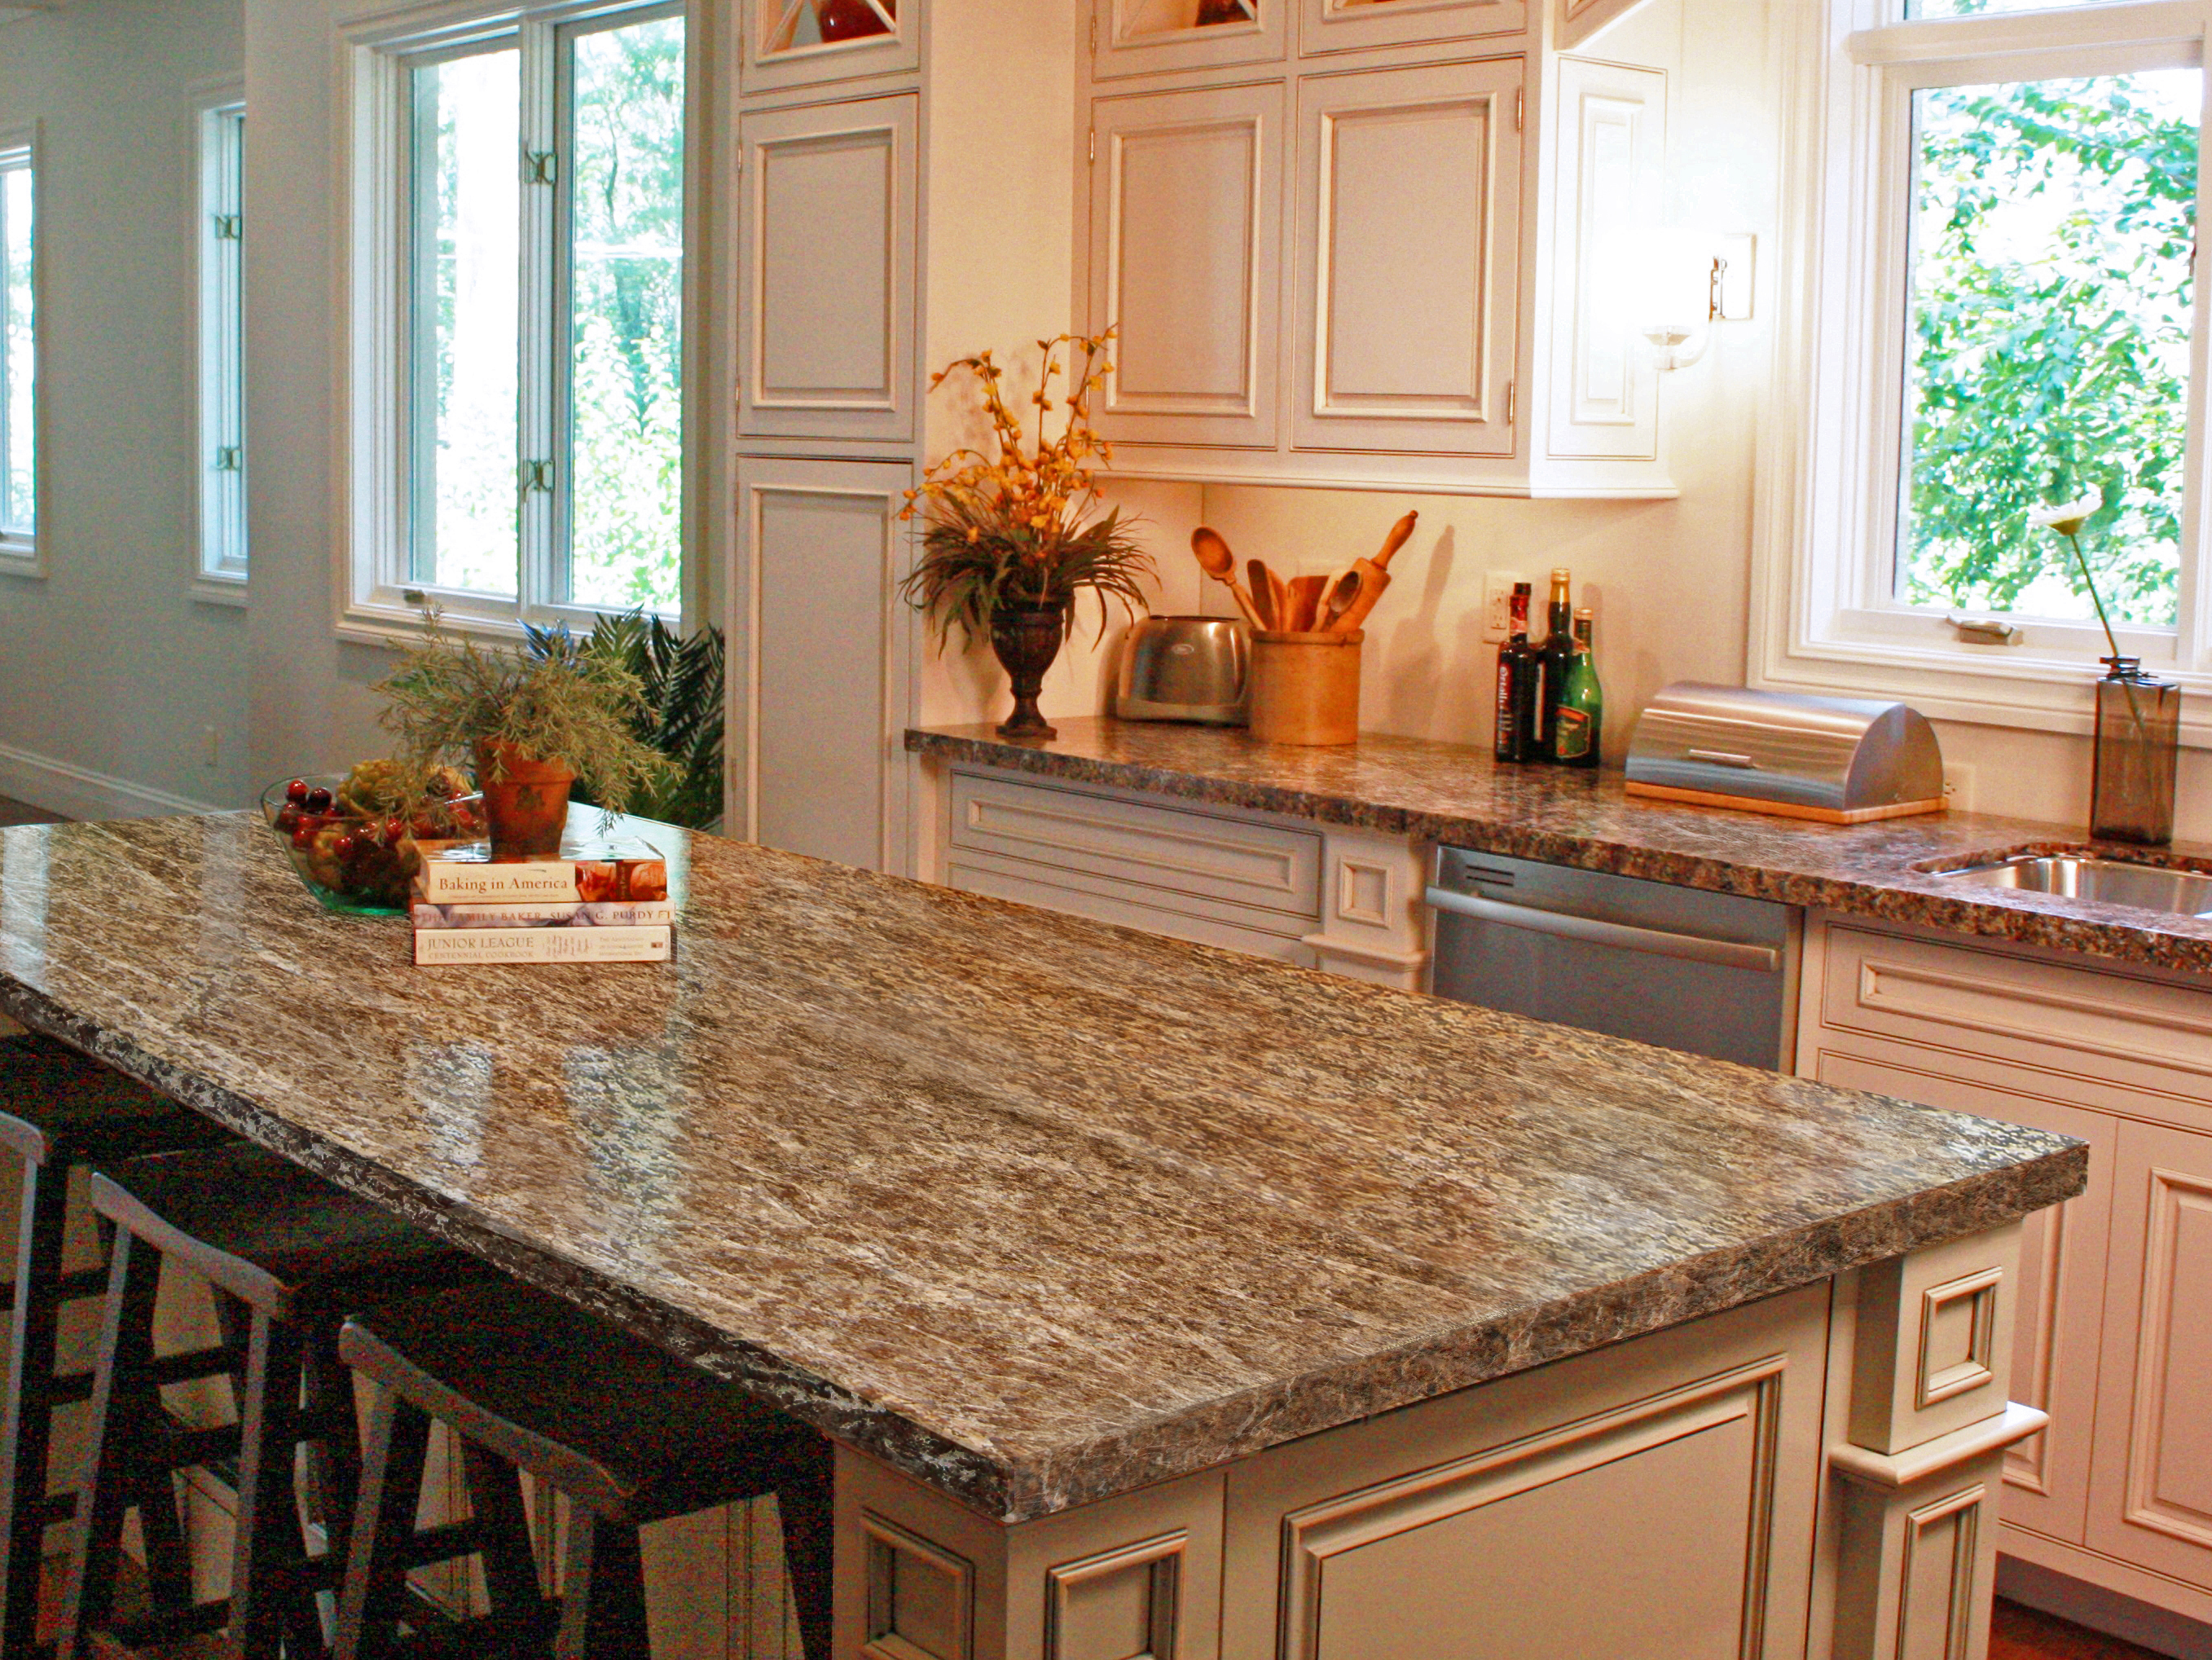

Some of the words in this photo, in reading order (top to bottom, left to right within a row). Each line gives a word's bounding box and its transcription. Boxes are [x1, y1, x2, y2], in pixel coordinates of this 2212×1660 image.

[440, 878, 486, 893] Baking
[491, 878, 504, 889] in
[509, 878, 567, 889] America
[501, 912, 541, 920] BAKER
[551, 911, 590, 919] SUSAN
[613, 910, 653, 919] PURDY
[428, 938, 476, 950] JUNIOR
[481, 937, 534, 948] LEAGUE
